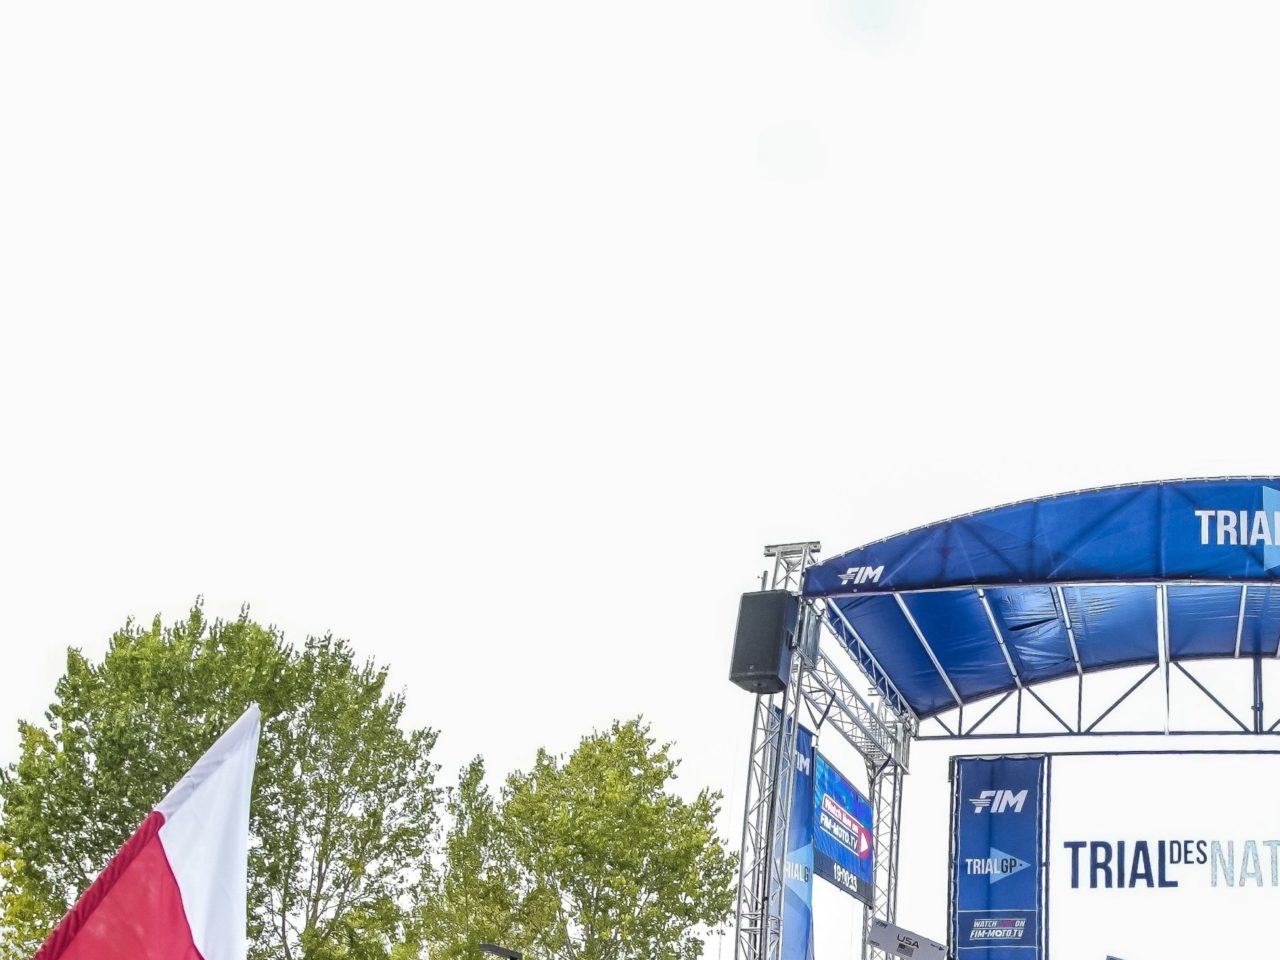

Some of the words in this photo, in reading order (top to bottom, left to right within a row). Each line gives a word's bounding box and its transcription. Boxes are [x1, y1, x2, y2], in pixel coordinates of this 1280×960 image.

[837, 565, 885, 585] FIM
[968, 789, 1029, 814] FIM
[965, 857, 1018, 876] TRIALGP
[1063, 840, 1179, 889] TRIAL
[1169, 840, 1208, 865] DES
[973, 920, 998, 928] WATCH
[1015, 919, 1026, 927] ON
[896, 934, 920, 949] USA
[970, 928, 1025, 939] FIM-MOTO.TV
